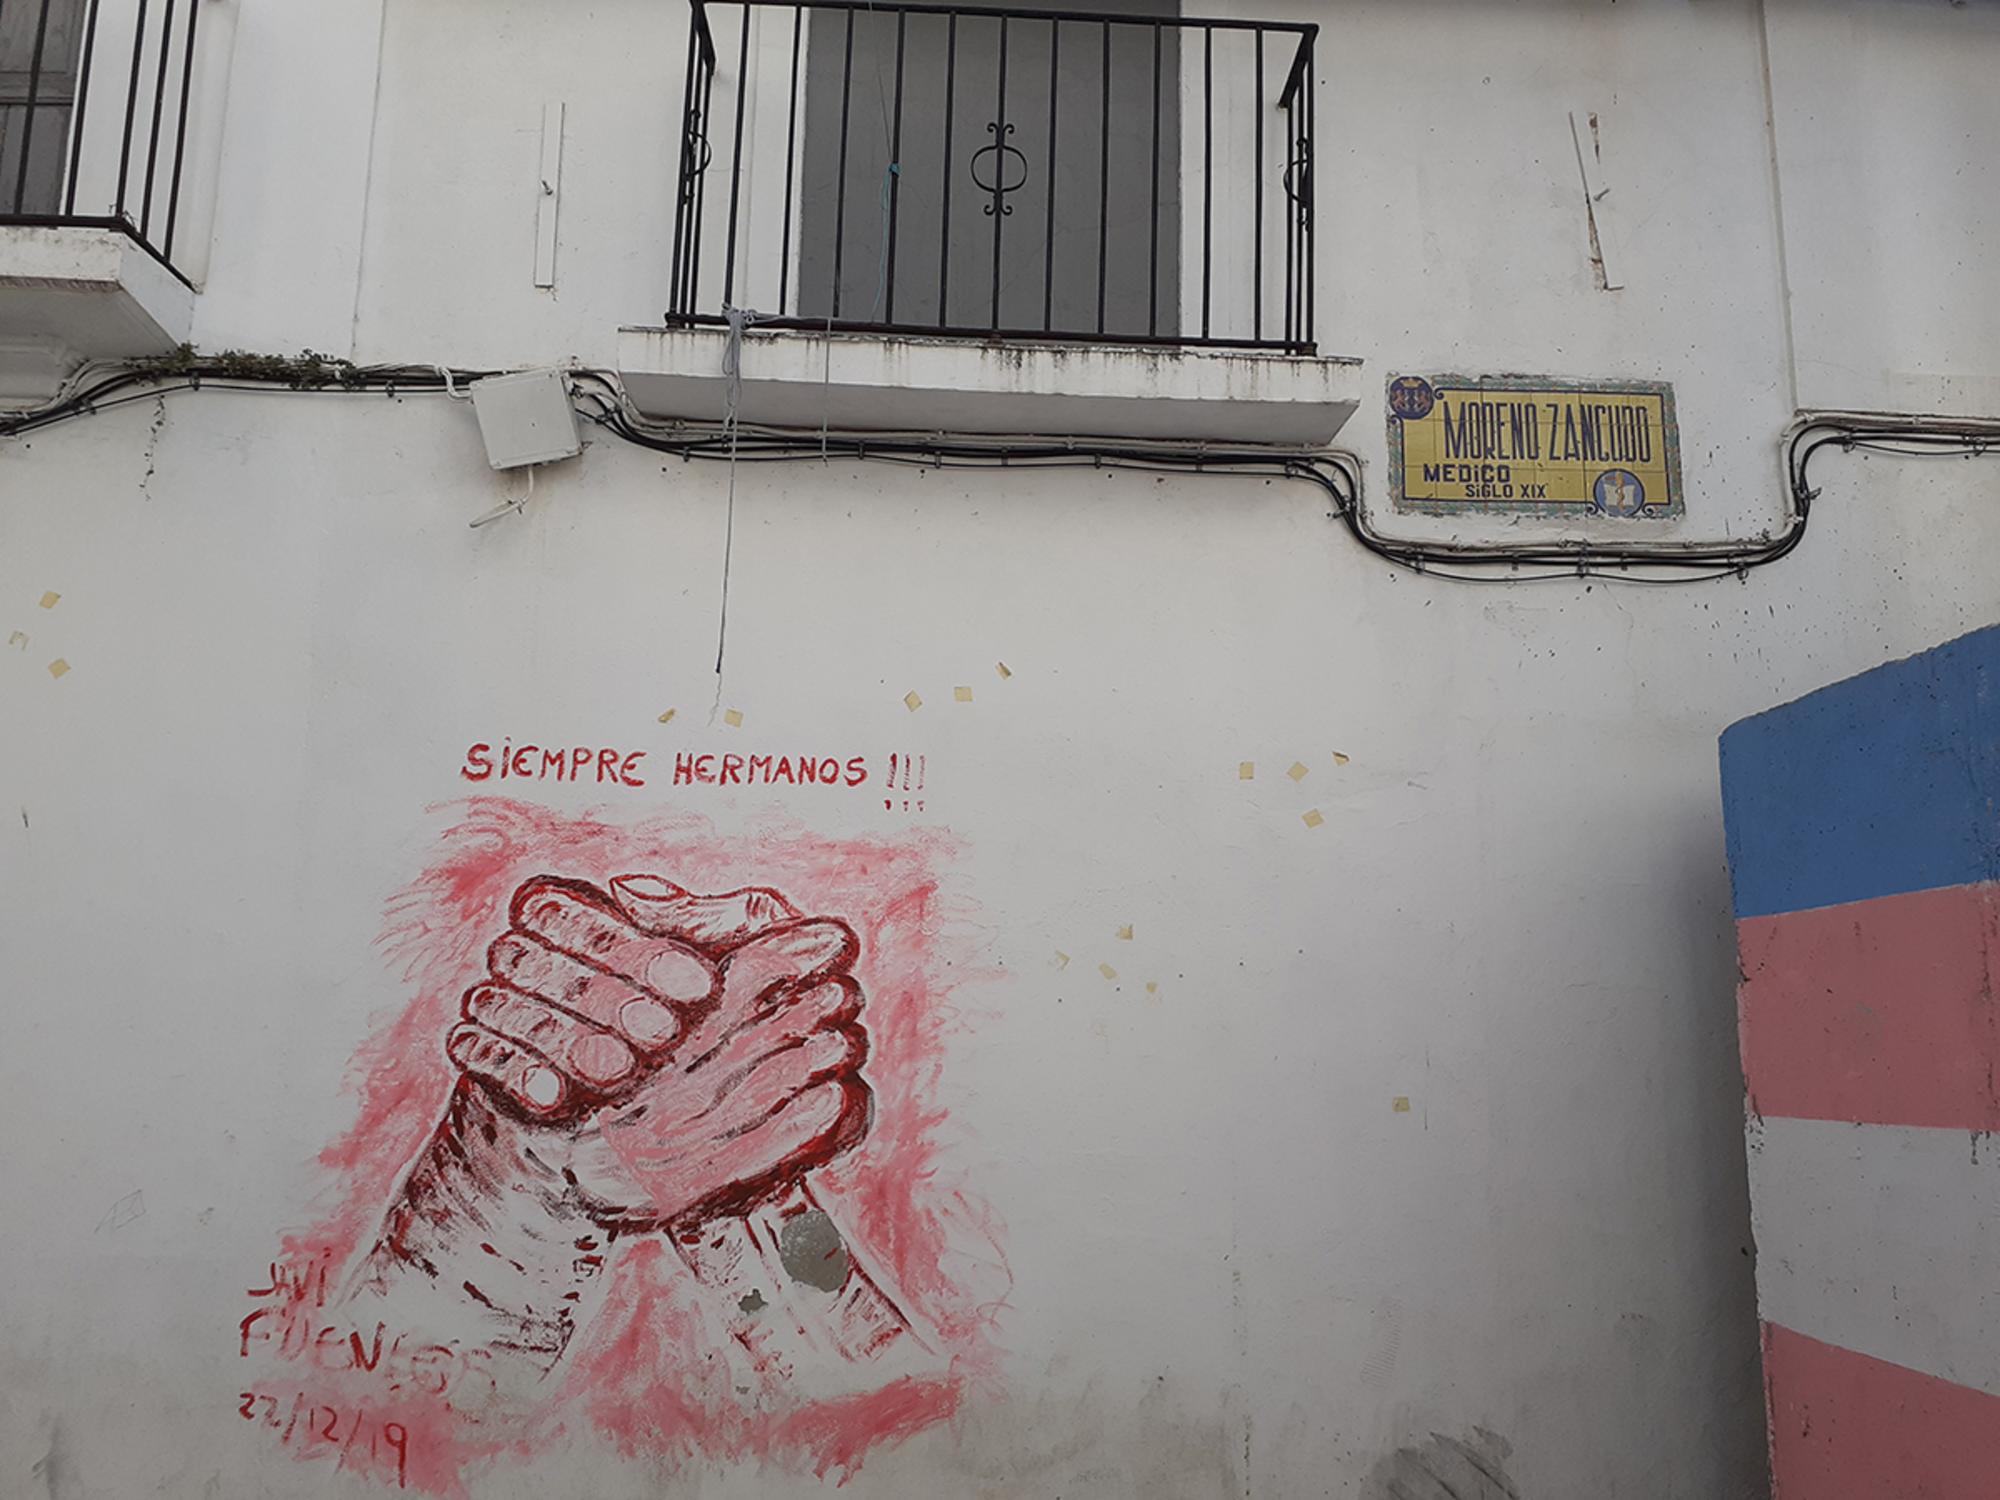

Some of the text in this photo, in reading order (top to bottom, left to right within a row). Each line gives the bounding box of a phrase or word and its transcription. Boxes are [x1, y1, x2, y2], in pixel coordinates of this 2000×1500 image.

[1442, 400, 1652, 463] MORENO ZANCUDO
[1520, 483, 1548, 499] XIX
[672, 751, 870, 788] HERMANOS
